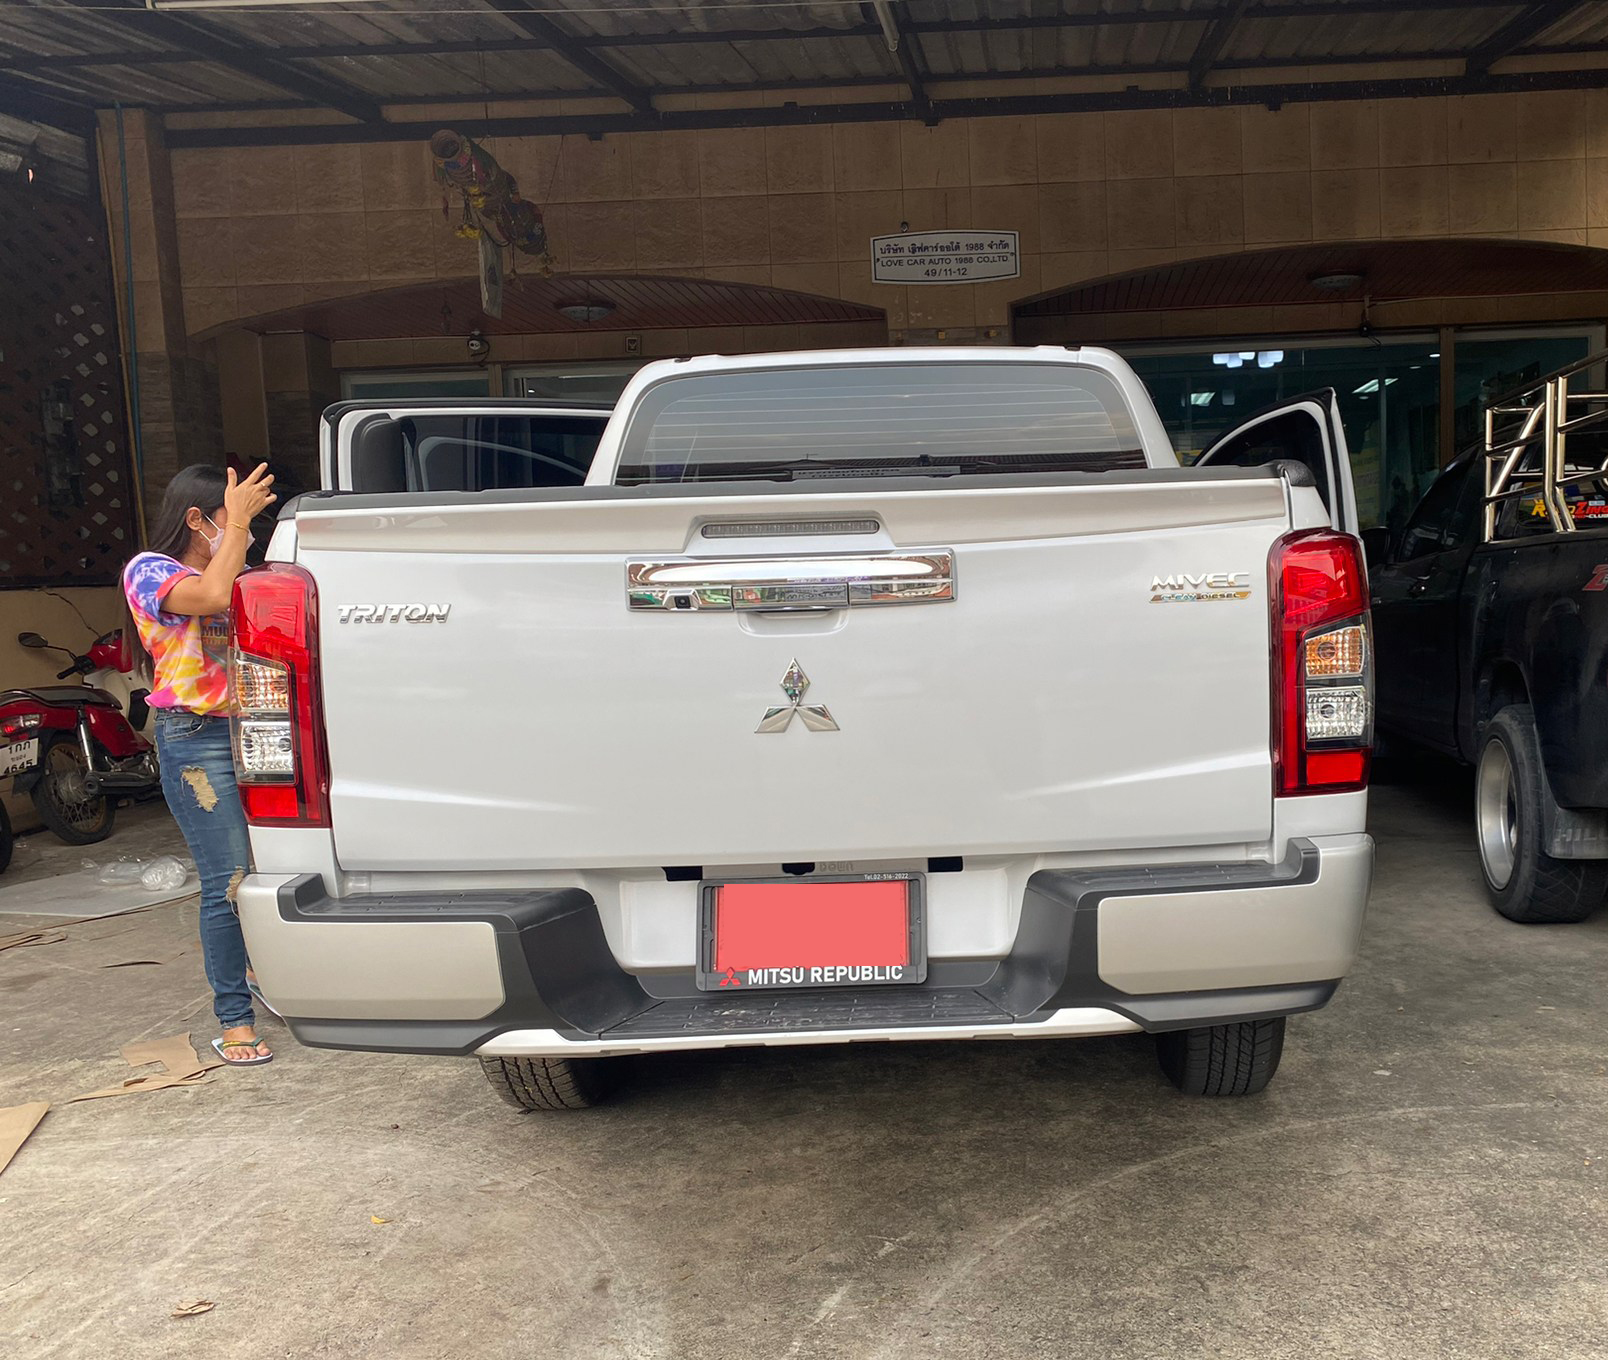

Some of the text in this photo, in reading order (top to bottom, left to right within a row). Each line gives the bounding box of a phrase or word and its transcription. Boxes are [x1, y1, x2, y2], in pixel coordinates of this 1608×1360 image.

[880, 243, 905, 254] บริษัท
[965, 242, 985, 251] 1988
[987, 240, 1010, 250] จำกัด
[881, 259, 904, 267] LOVE
[906, 258, 926, 266] CAR
[928, 256, 951, 266] AUTO
[954, 256, 974, 265] 1988
[1150, 572, 1250, 591] MIVEC
[338, 603, 452, 625] TRITON
[4, 758, 33, 774] 4645
[748, 965, 903, 985] MITSU REPUBLIC
